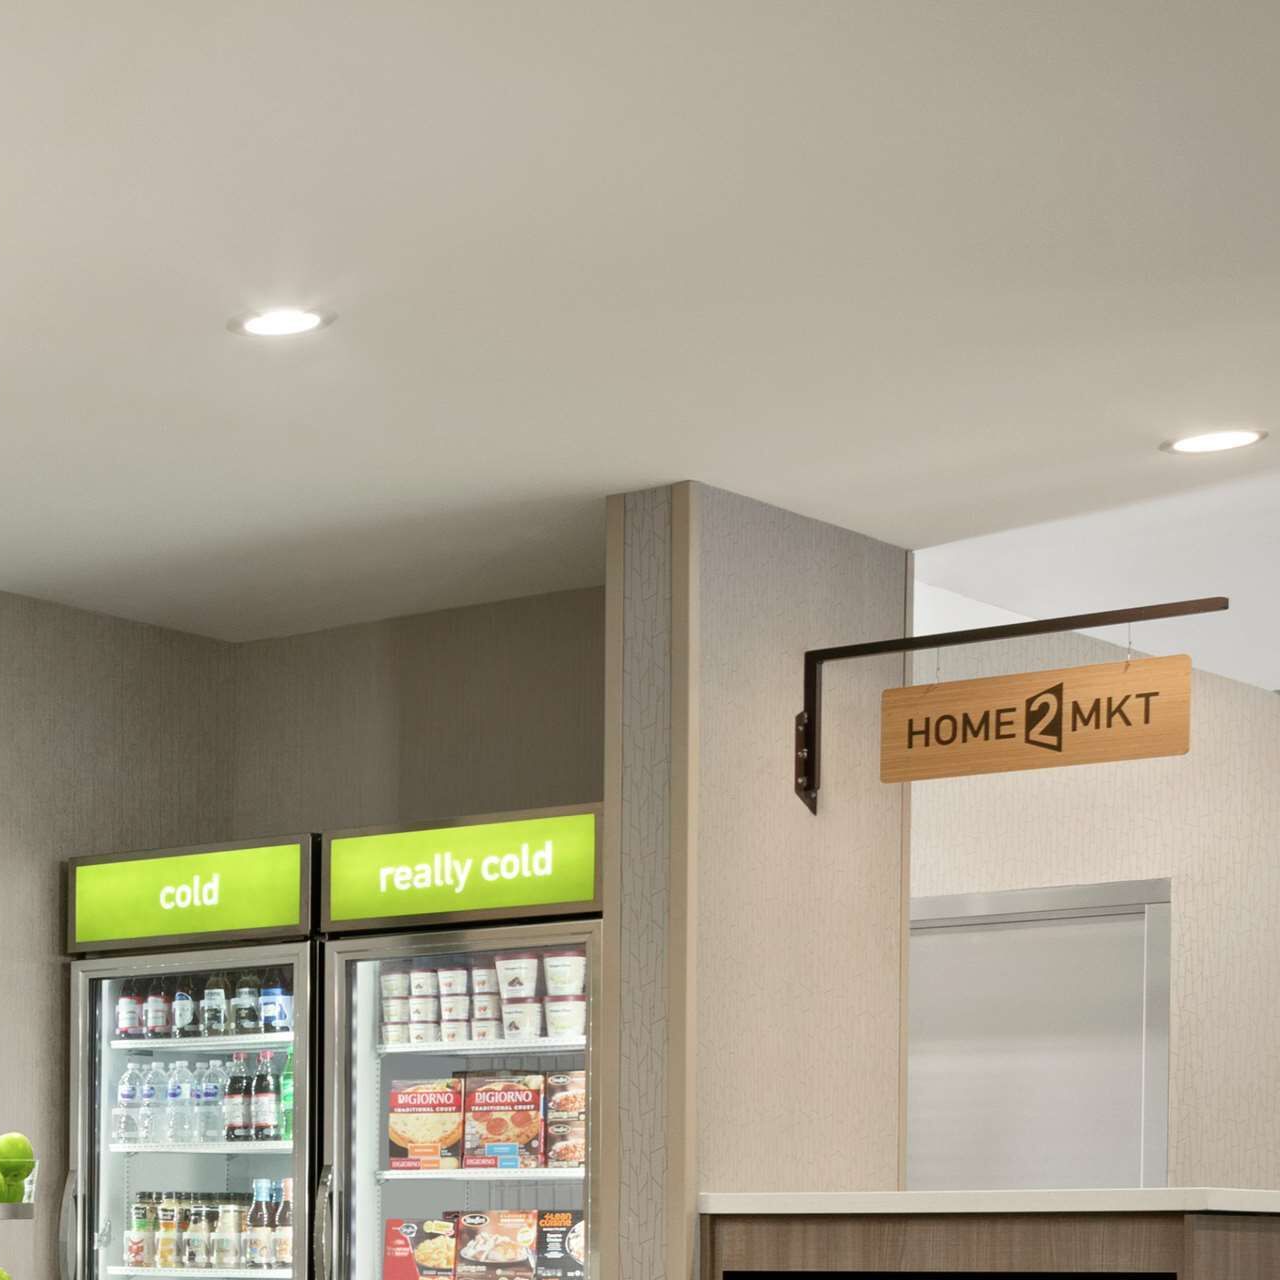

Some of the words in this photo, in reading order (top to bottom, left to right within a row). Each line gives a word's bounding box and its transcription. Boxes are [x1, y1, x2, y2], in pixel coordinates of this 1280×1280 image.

[907, 707, 1017, 749] HOME
[1027, 689, 1061, 749] 2
[1072, 692, 1159, 732] MKT
[159, 873, 220, 910] cold
[379, 852, 472, 894] really
[481, 840, 553, 882] cold
